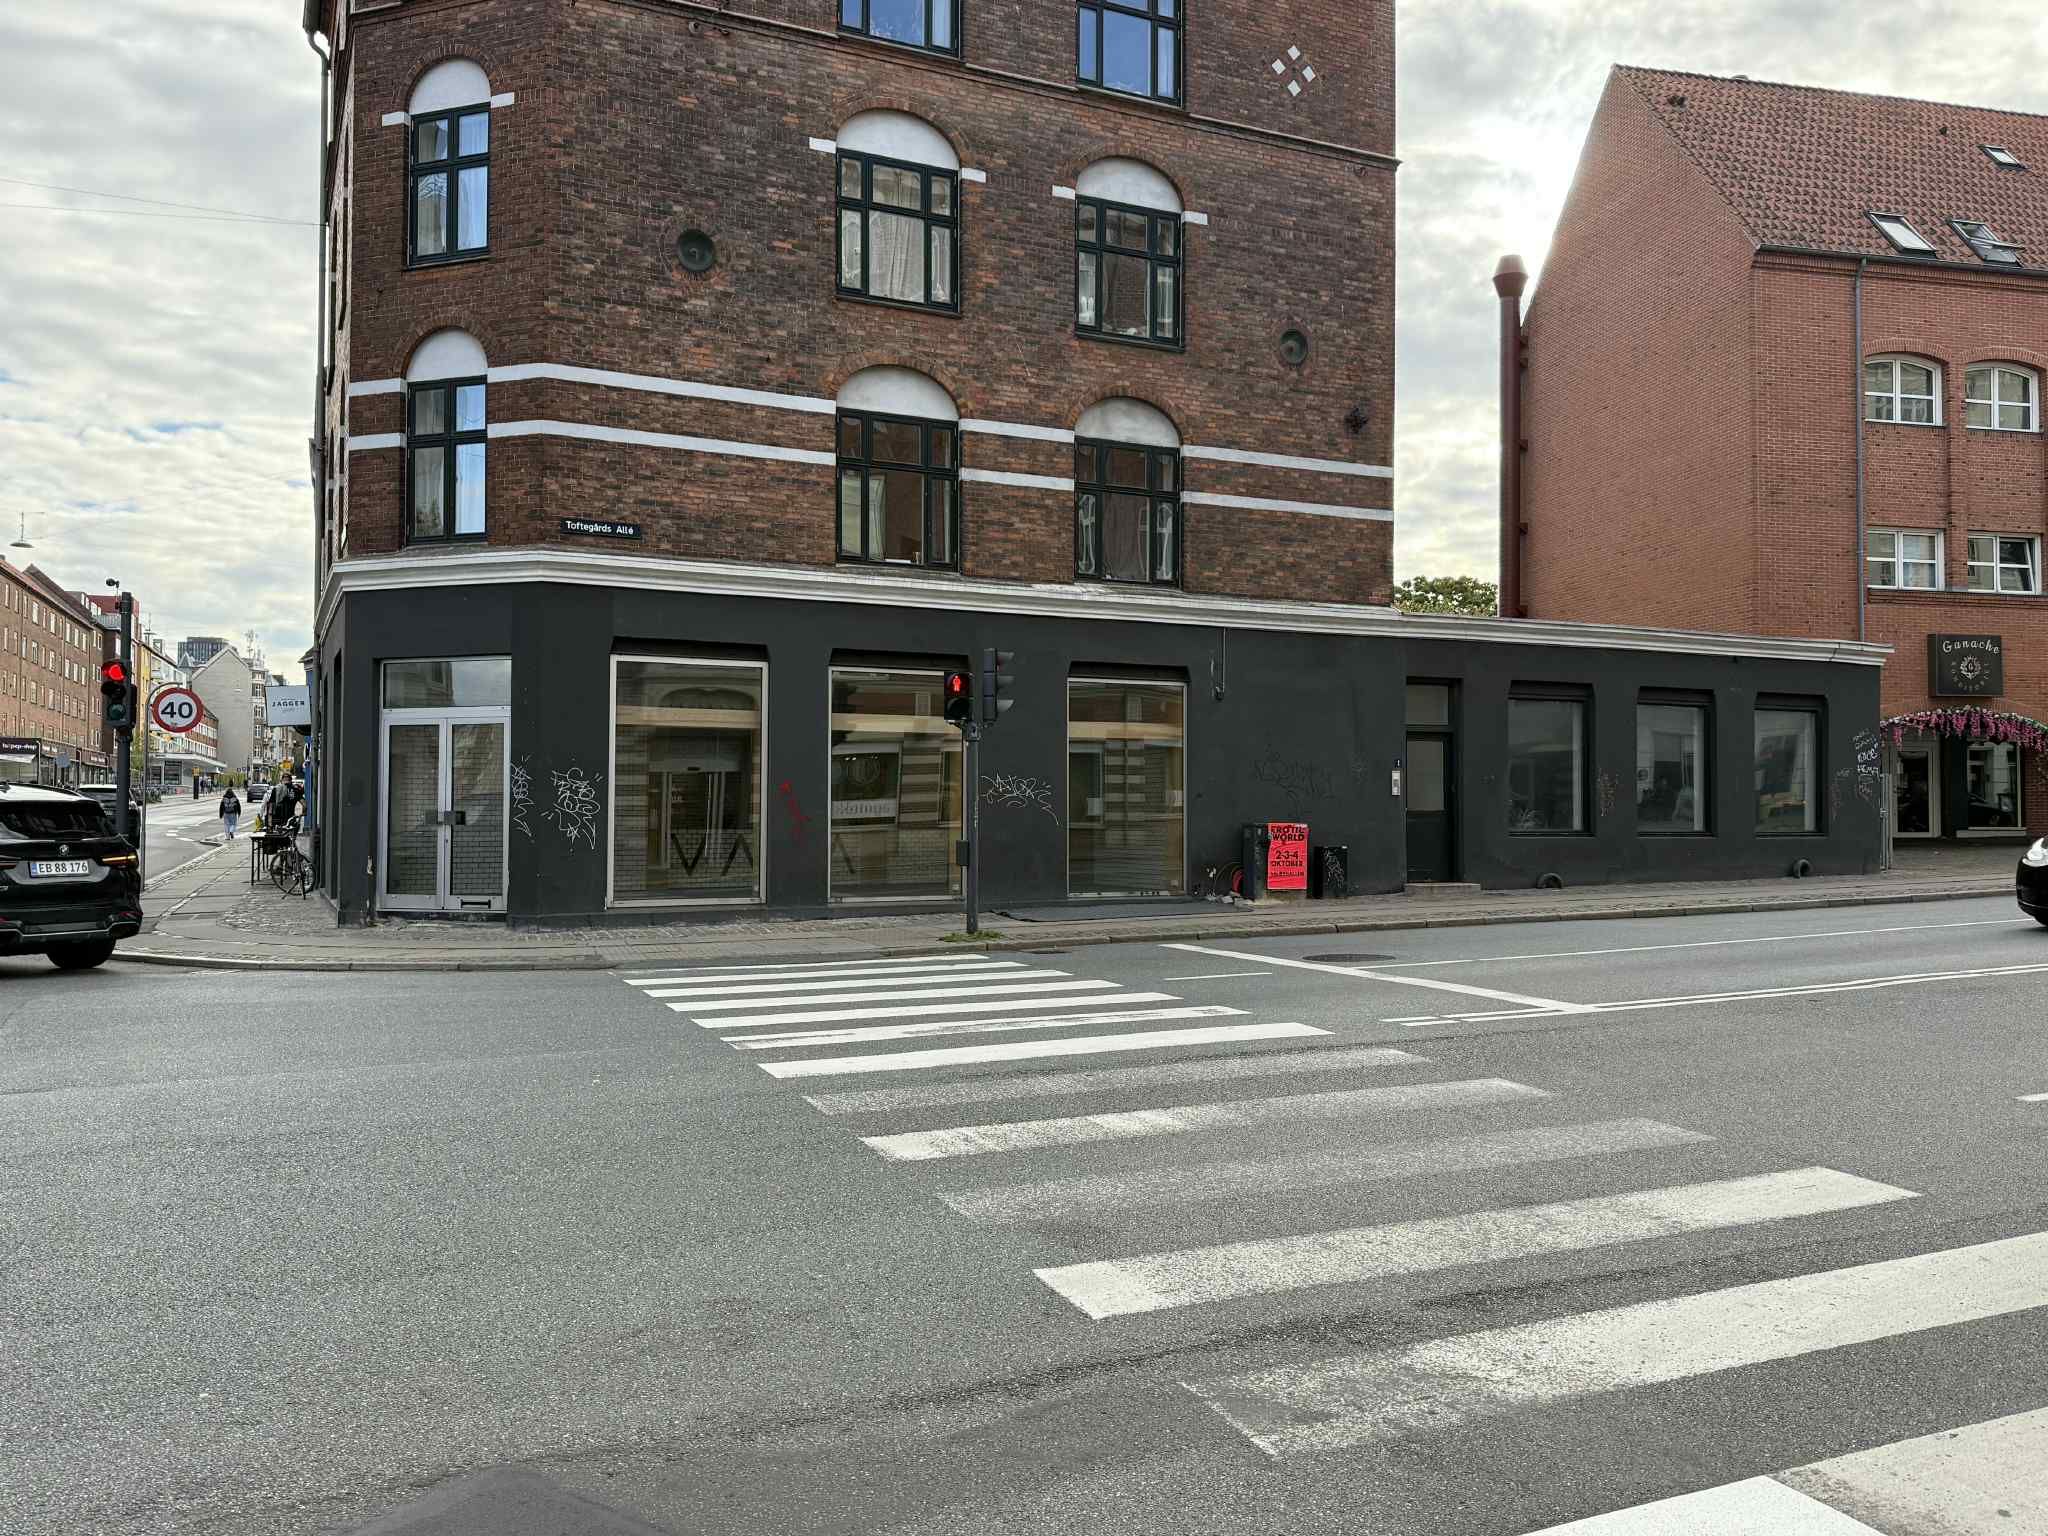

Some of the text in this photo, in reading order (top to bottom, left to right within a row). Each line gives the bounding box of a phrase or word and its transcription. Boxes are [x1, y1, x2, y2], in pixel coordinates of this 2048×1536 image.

[566, 520, 634, 535] Toftegårds Allé
[1942, 639, 2000, 654] Ganache
[272, 700, 305, 708] JAGGER
[160, 701, 194, 719] 40
[1272, 833, 1305, 841] WORLD
[1275, 850, 1299, 860] 2-3-4
[38, 862, 88, 873] EB 88 176
